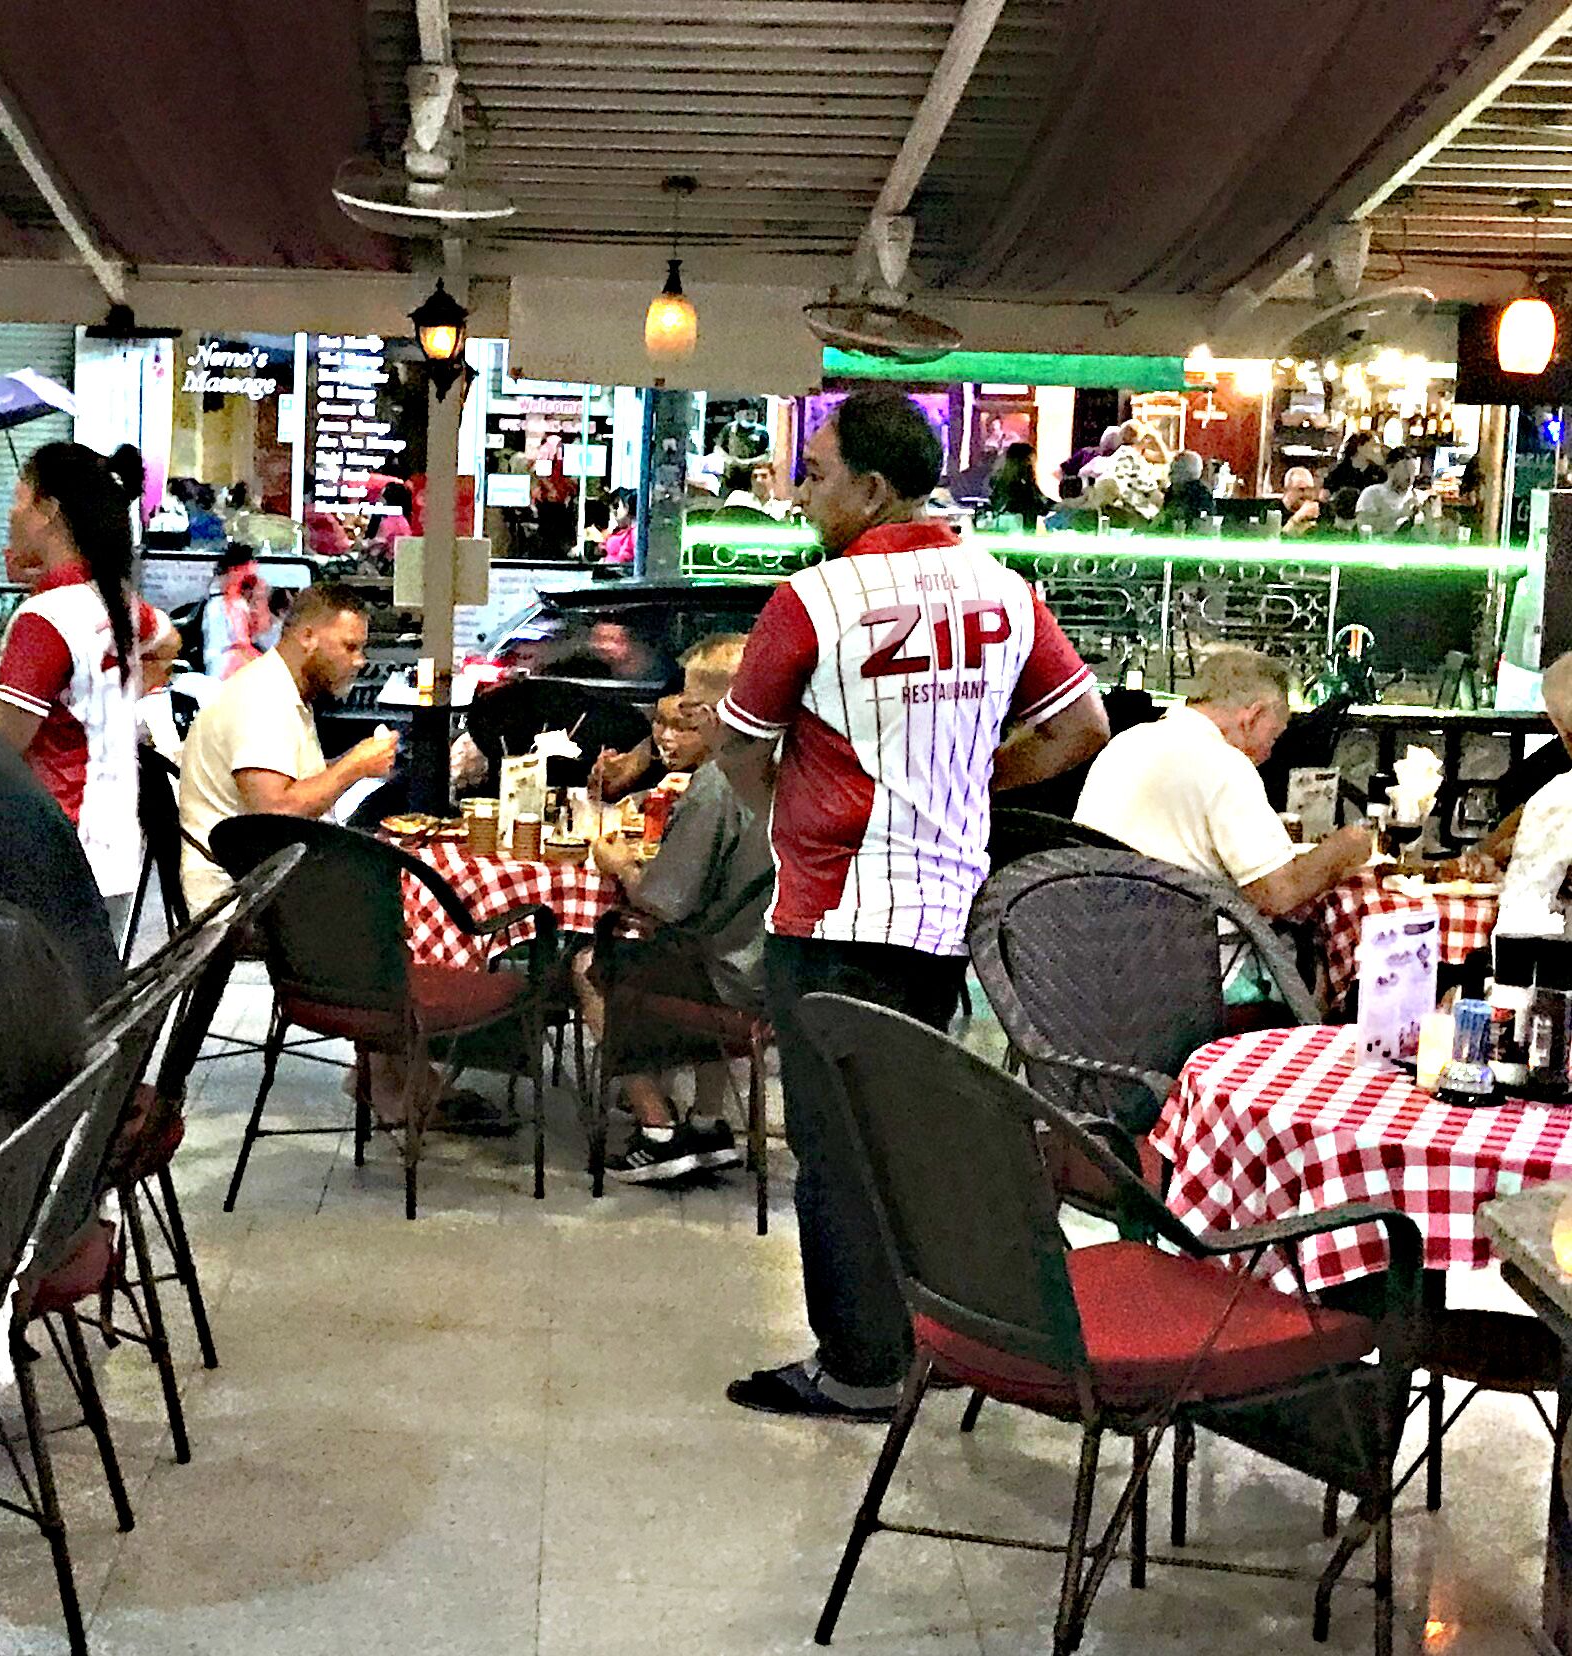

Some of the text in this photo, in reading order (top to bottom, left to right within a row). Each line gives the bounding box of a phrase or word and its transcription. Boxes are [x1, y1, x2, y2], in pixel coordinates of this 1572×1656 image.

[187, 341, 269, 368] Nemo's
[181, 370, 277, 401] Massage
[914, 573, 960, 592] HOTEL
[859, 600, 1012, 679] ZIP
[901, 680, 989, 704] RESTAURANT
